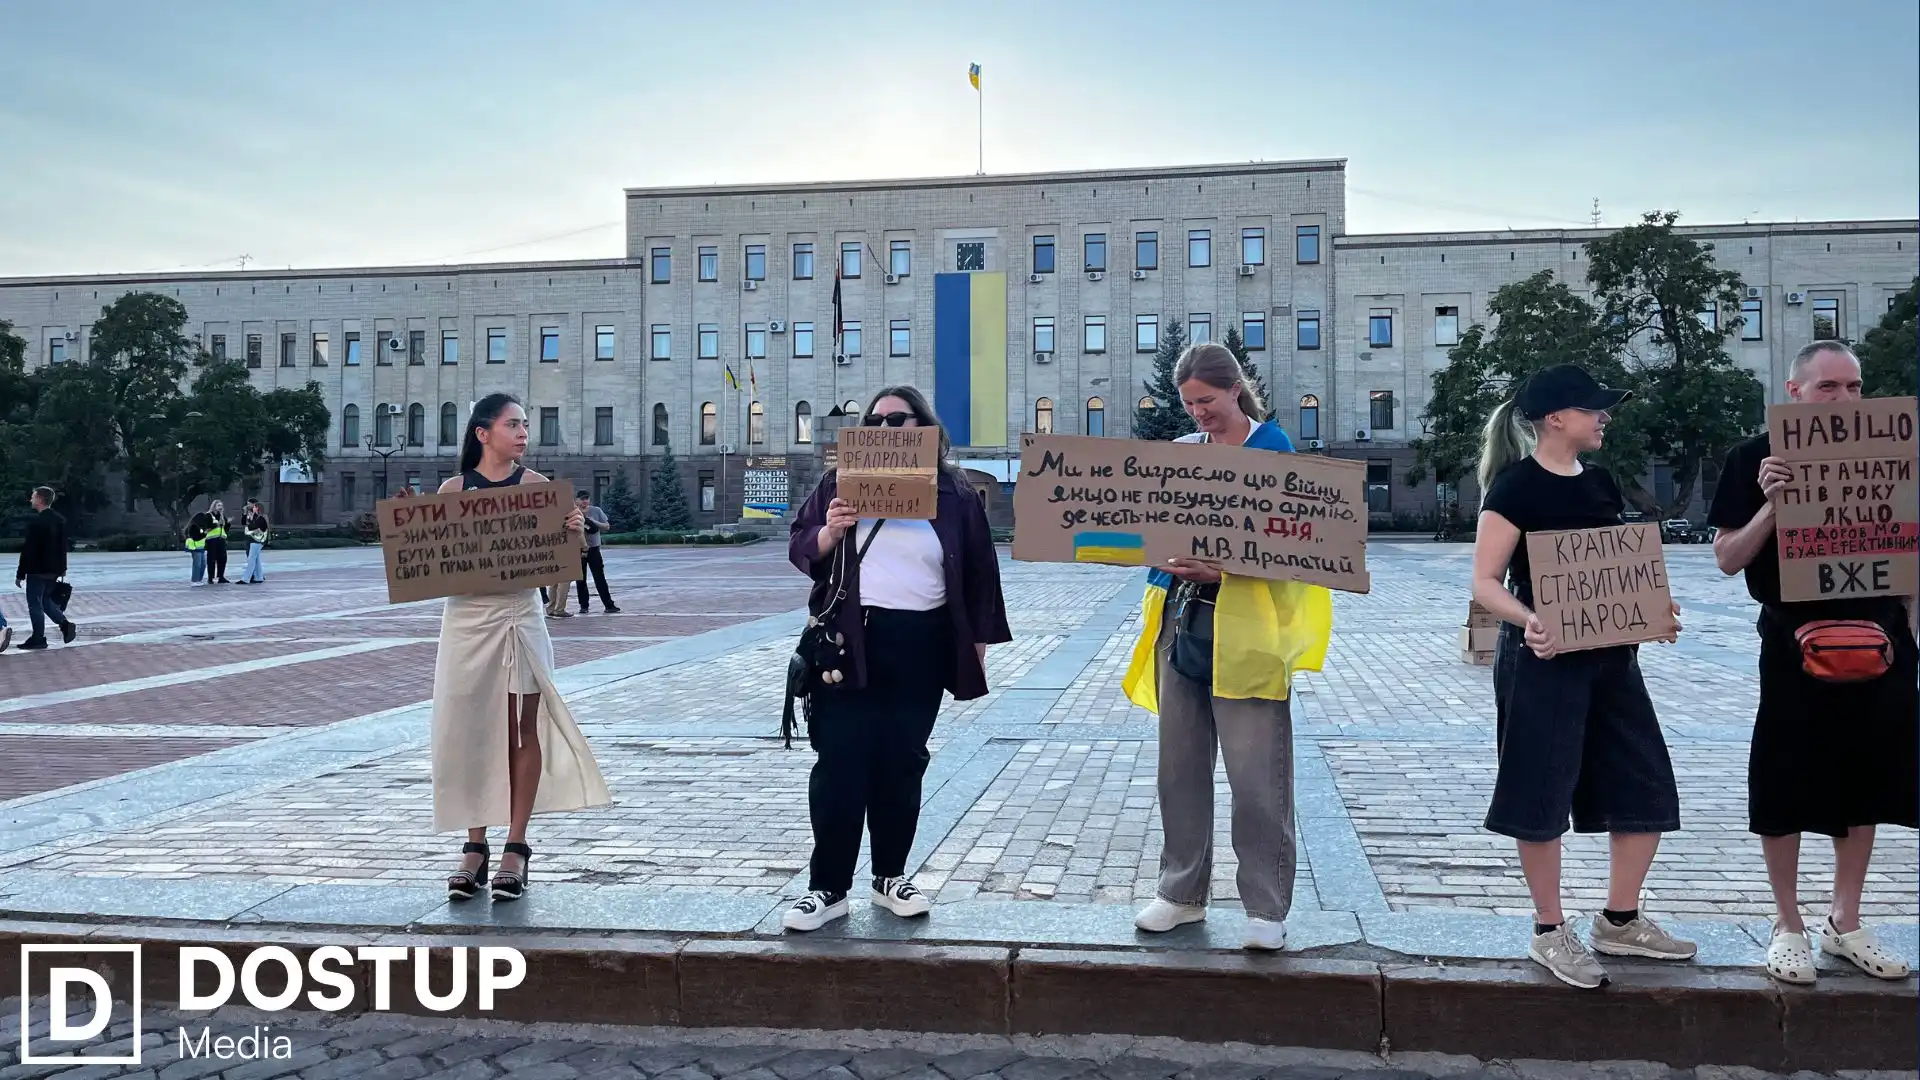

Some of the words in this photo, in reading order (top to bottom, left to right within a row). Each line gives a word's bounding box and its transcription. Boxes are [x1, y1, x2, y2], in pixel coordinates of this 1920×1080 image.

[846, 430, 923, 447] ПОВЕРНЕННЯ
[1783, 410, 1913, 449] НАВІЩО
[859, 482, 897, 497] МАЄ
[1090, 465, 1114, 477] не
[1243, 473, 1277, 491] цю
[1783, 485, 1829, 504] ПІВ
[1842, 484, 1895, 501] РОКУ
[393, 503, 446, 527] БУТИ
[459, 491, 558, 518] УКРАЇНЦЕМ
[1823, 503, 1893, 526] ЯКЩО
[402, 523, 469, 544] ЗНАЧИТЬ
[473, 514, 538, 536] ПОСТІЙНО
[1243, 515, 1256, 532] А
[1785, 527, 1867, 543] ФЕДОРОВ
[1874, 523, 1901, 536] МО
[398, 547, 435, 564] БУТИ
[1240, 541, 1355, 574] Драпатий
[1554, 527, 1646, 565] КРАПКУ
[1786, 544, 1826, 559] БУДЕ
[1539, 559, 1667, 606] СТАВИТИМЕ
[1819, 560, 1890, 593] ВЖЕ
[1561, 601, 1648, 643] НАРОД
